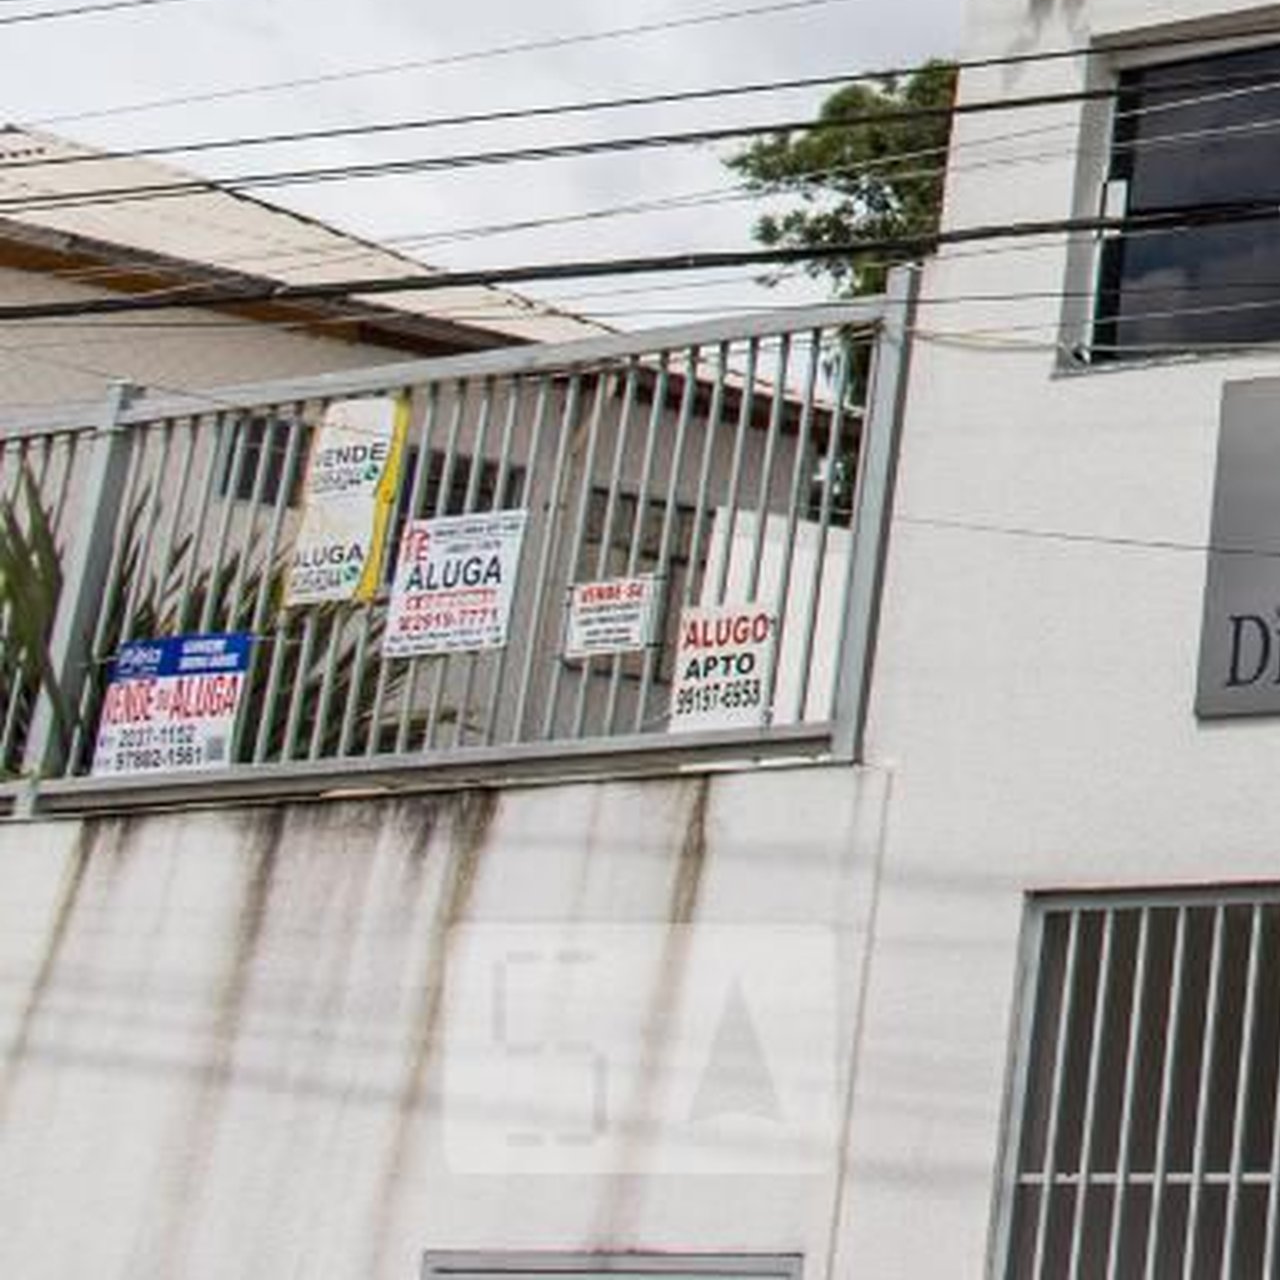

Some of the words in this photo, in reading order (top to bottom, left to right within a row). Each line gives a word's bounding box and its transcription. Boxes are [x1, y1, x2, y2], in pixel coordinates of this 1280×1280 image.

[404, 555, 503, 593] ALUGA
[682, 612, 769, 651] ALUGO
[684, 652, 756, 680] APTO
[169, 675, 239, 720] ALUGA
